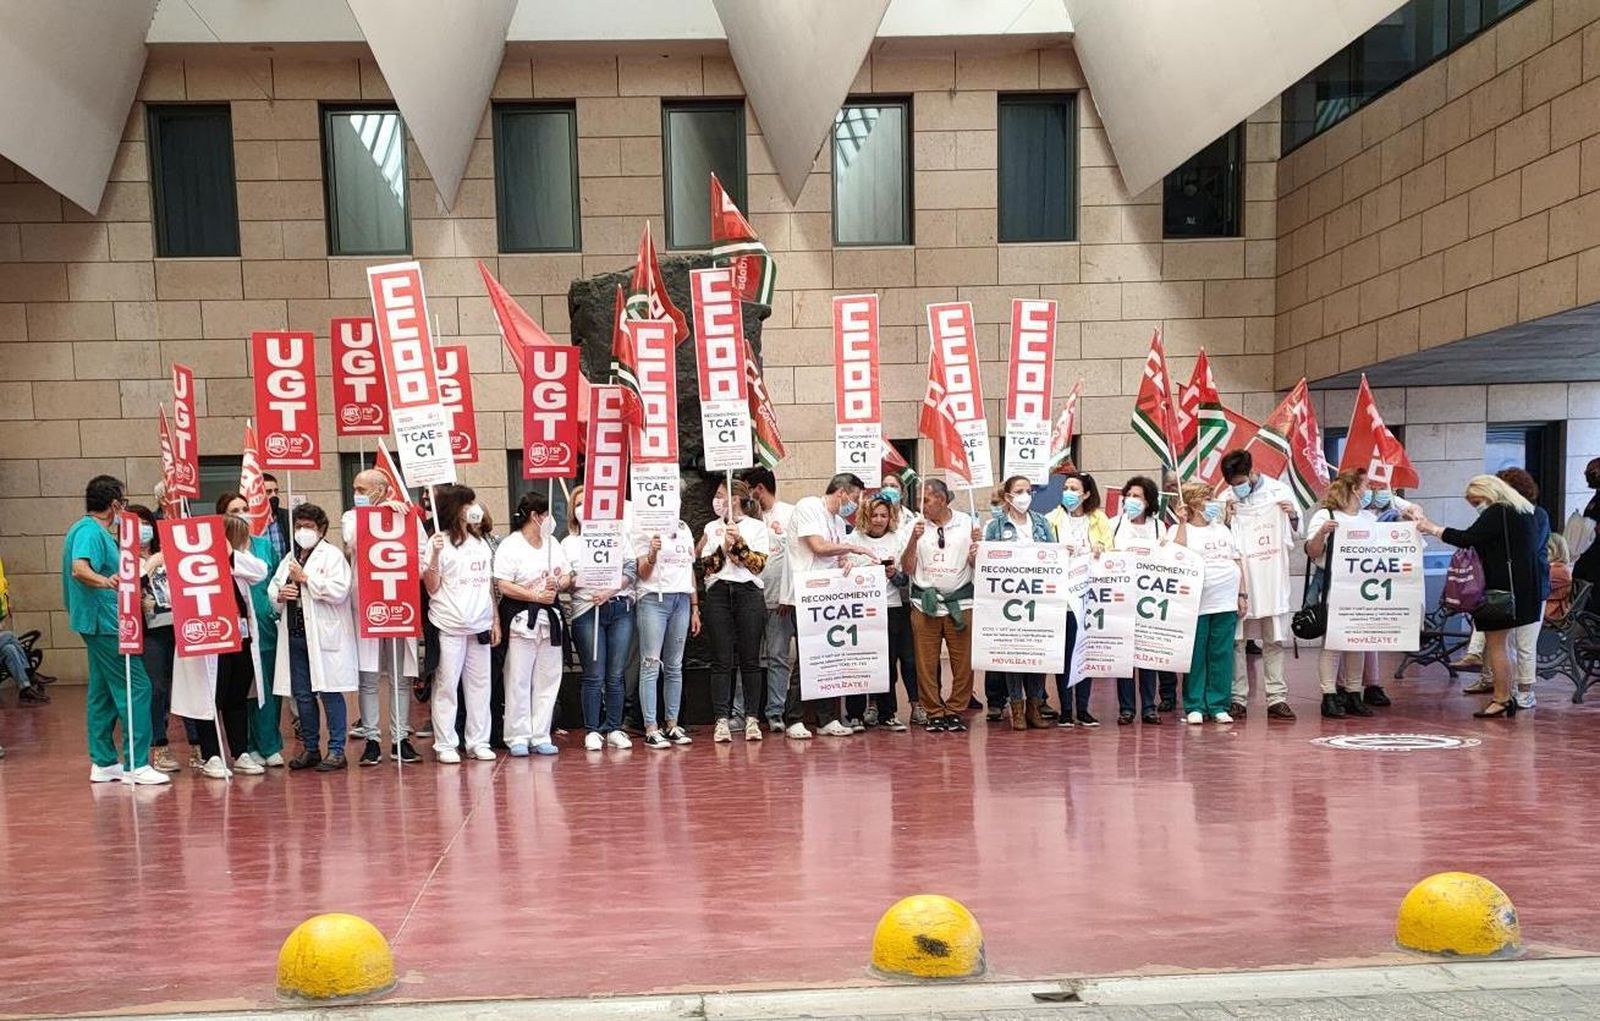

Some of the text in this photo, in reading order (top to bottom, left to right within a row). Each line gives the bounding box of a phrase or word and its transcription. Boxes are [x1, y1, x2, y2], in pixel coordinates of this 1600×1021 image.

[381, 276, 429, 403] CCOO
[700, 271, 740, 400] CCOO
[340, 322, 377, 403] UGT
[842, 302, 872, 419] CCOO
[938, 309, 976, 421] CCOO
[1015, 302, 1049, 421] CCOO
[266, 338, 307, 432] UGT
[532, 351, 568, 441] UGT
[637, 328, 669, 457] CCOO
[173, 369, 192, 460] UGT
[718, 430, 736, 443] C1
[963, 439, 983, 448] AE=
[415, 443, 435, 457] C1
[591, 388, 622, 519] CCOO
[850, 451, 867, 463] C1
[1019, 448, 1036, 460] C1
[647, 494, 665, 507] C1
[119, 518, 136, 613] UGT
[368, 511, 408, 600] UGT
[593, 551, 609, 563] C1
[172, 522, 222, 616] UGT
[981, 565, 1063, 575] RECONOCIMIENTO
[1136, 562, 1199, 577] ONOCIMIENTO
[801, 590, 881, 604] RECONOCIMIENTO
[1137, 575, 1190, 594] CAE=
[1360, 578, 1392, 601] C1
[1003, 599, 1036, 622] C1
[1136, 596, 1169, 621] C1
[826, 624, 858, 647] C1
